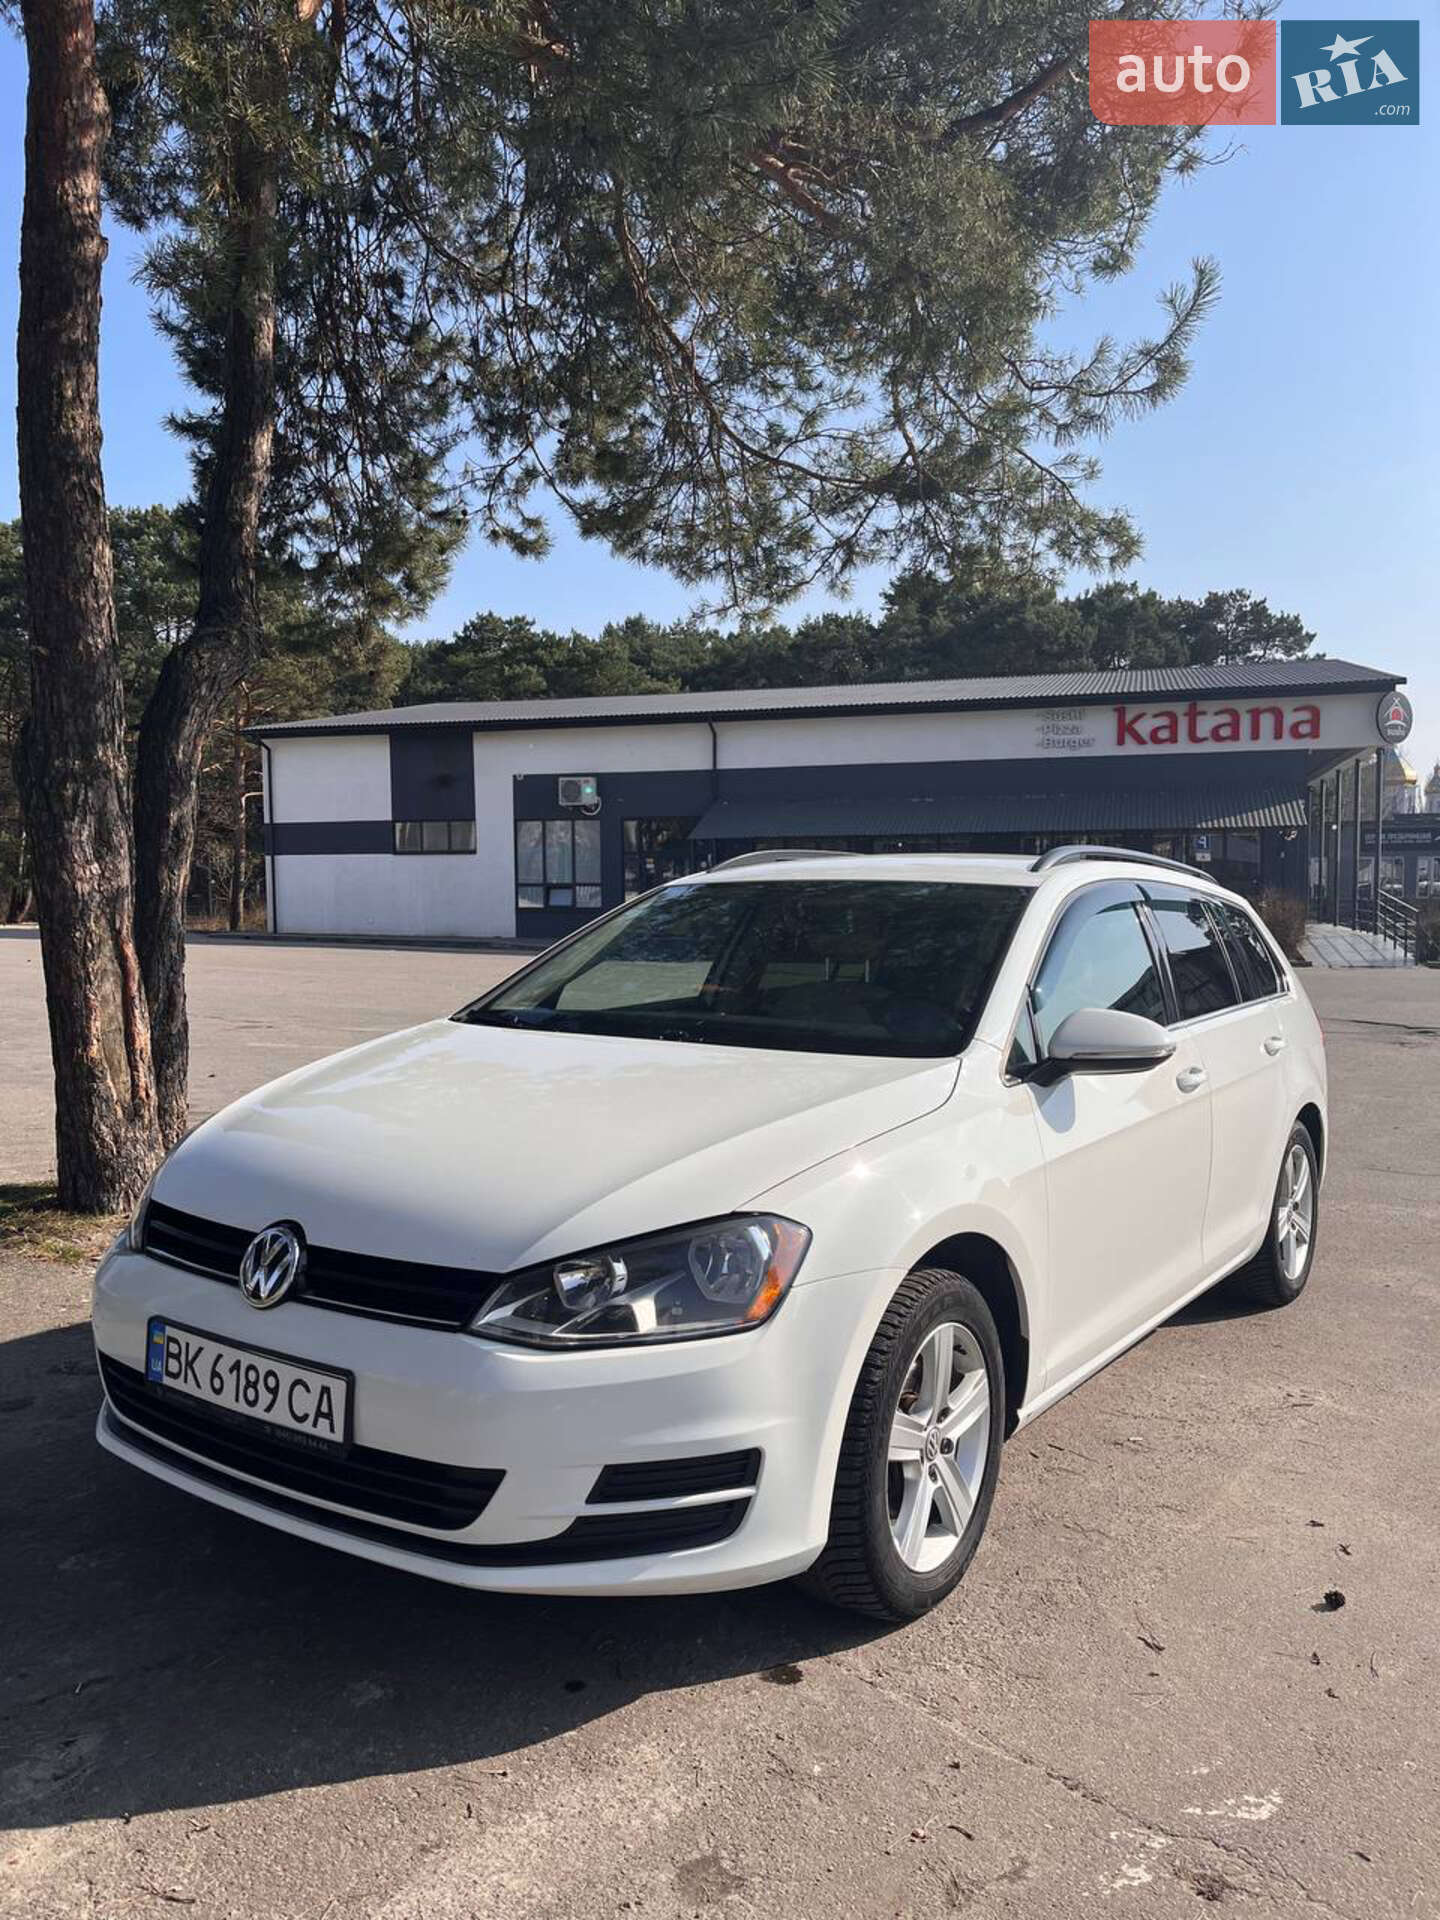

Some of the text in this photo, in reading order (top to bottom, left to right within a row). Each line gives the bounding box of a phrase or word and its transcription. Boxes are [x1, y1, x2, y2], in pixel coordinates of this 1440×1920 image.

[1112, 701, 1321, 746] katana
[165, 1335, 336, 1434] BK 6189 CA
